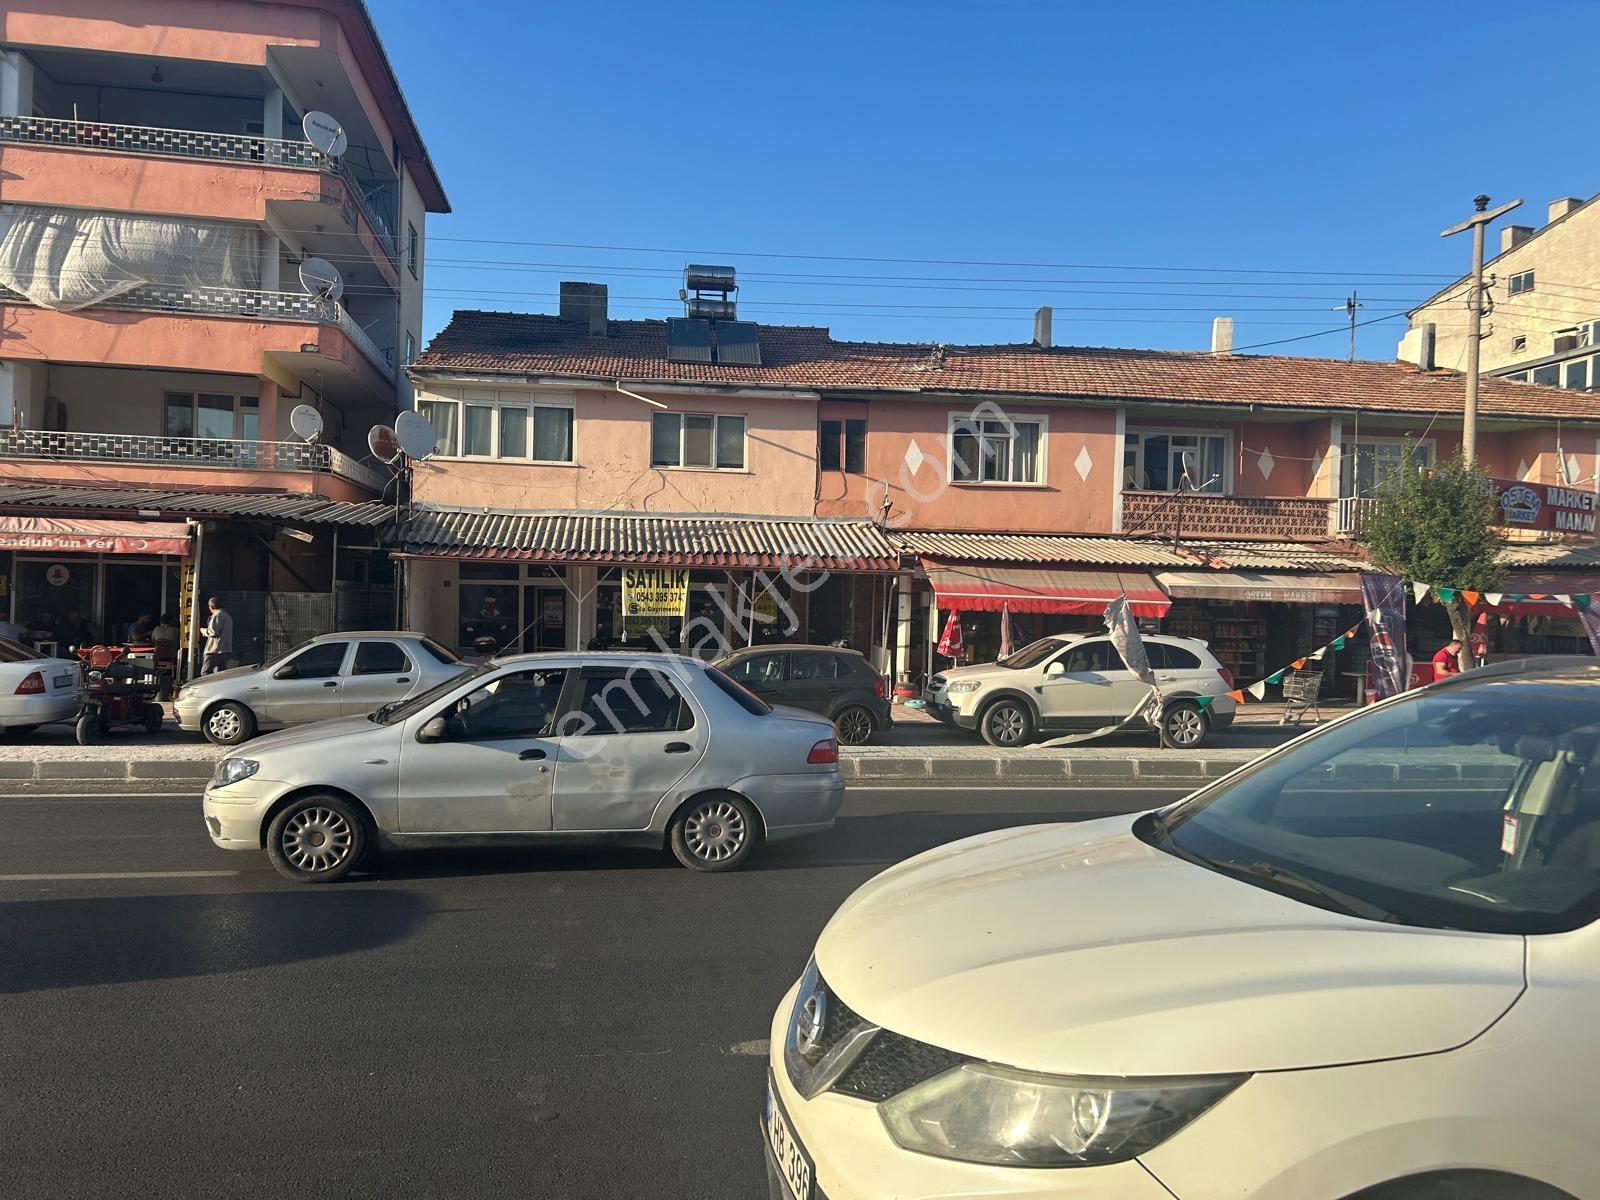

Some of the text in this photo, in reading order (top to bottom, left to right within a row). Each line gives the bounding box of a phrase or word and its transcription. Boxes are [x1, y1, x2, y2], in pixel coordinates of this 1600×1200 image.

[1546, 487, 1598, 511] MARKET
[1556, 511, 1597, 532] MANAV
[86, 539, 120, 549] Yeri
[626, 568, 686, 588] SATILIK
[636, 592, 653, 602] 0543
[655, 592, 668, 602] 395
[773, 1111, 785, 1162] HB
